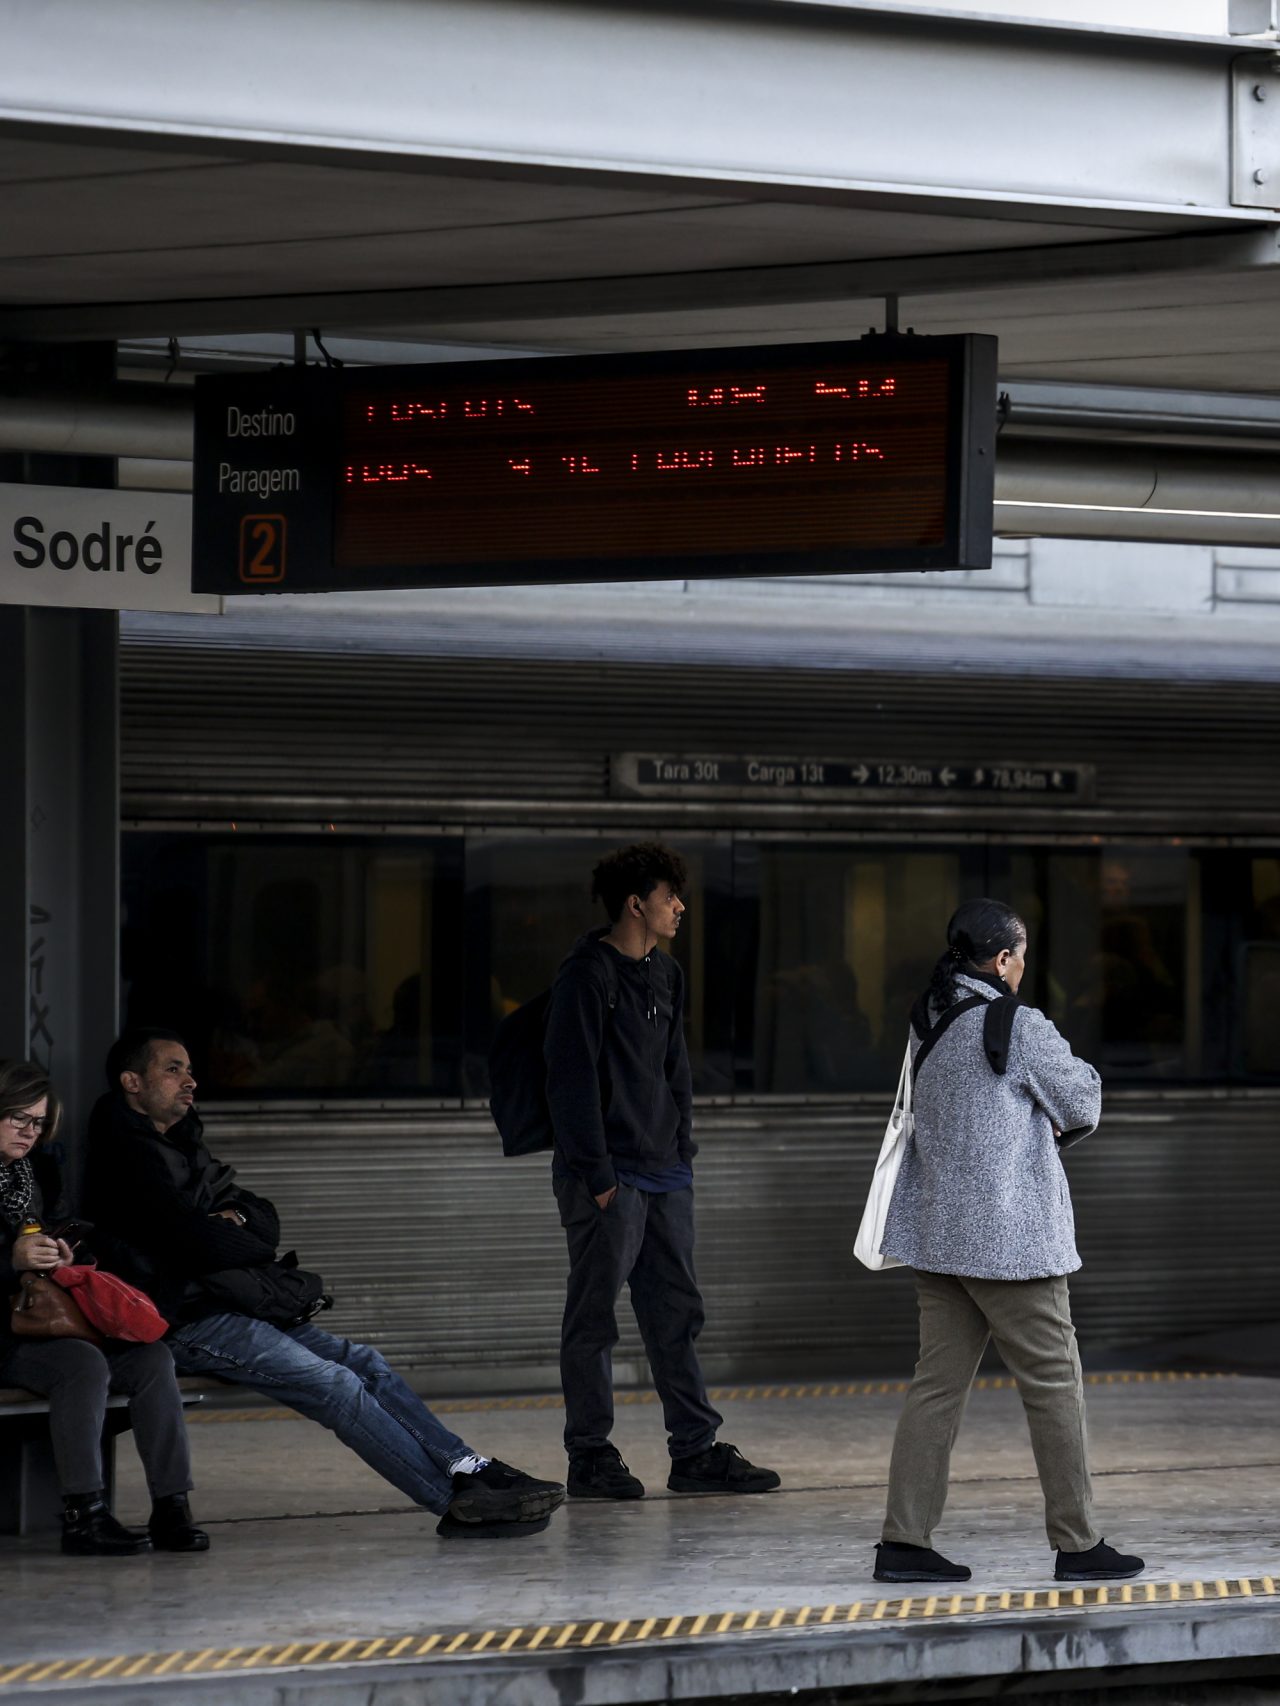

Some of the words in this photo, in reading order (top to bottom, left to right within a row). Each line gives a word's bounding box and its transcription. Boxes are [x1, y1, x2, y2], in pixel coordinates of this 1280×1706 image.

[227, 404, 296, 438] Destino
[218, 463, 300, 500] Paragem
[12, 516, 163, 575] Sodré
[249, 521, 276, 576] 2
[653, 760, 690, 781] Tara
[694, 761, 719, 781] 30t
[747, 761, 795, 787] Carga
[801, 764, 824, 783] 13t
